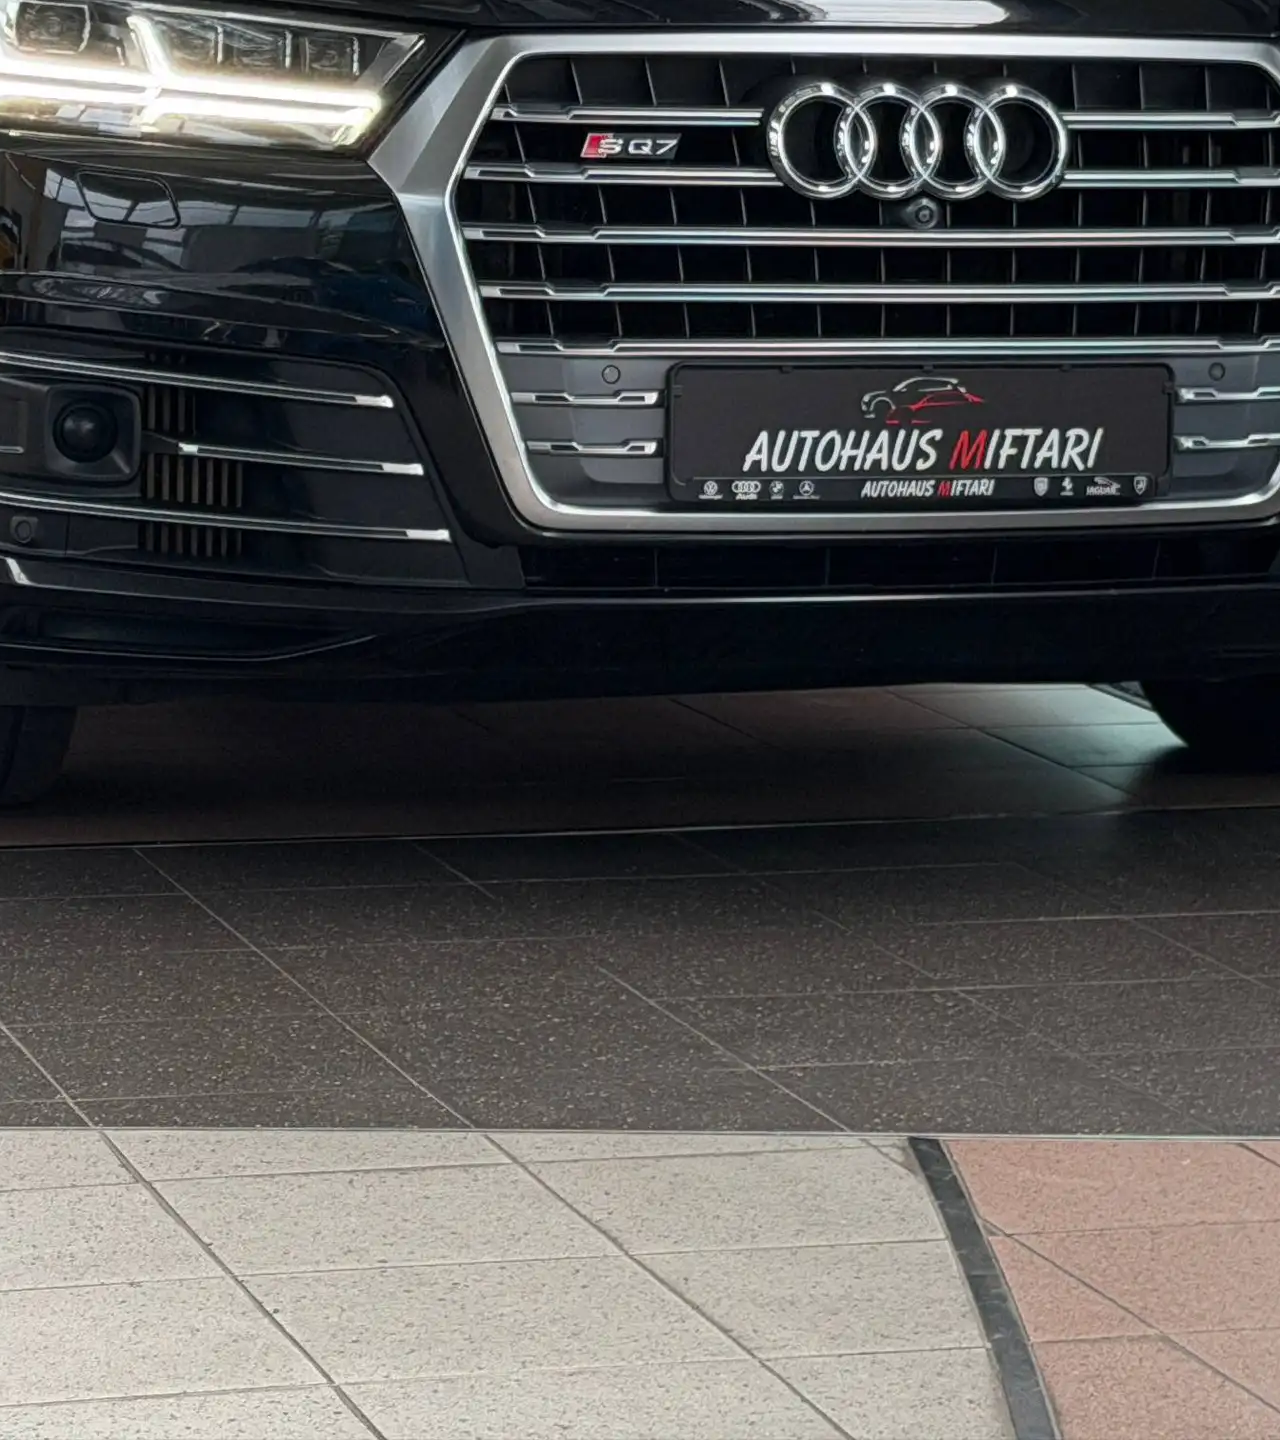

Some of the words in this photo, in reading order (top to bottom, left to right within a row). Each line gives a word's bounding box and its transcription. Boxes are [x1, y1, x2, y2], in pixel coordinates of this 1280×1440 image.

[598, 138, 680, 155] SQ7
[742, 428, 943, 472] AUTOHAUS
[949, 427, 1104, 471] MIFTARI
[860, 479, 935, 498] AUTOHAUS
[937, 478, 995, 497] MIFTARI
